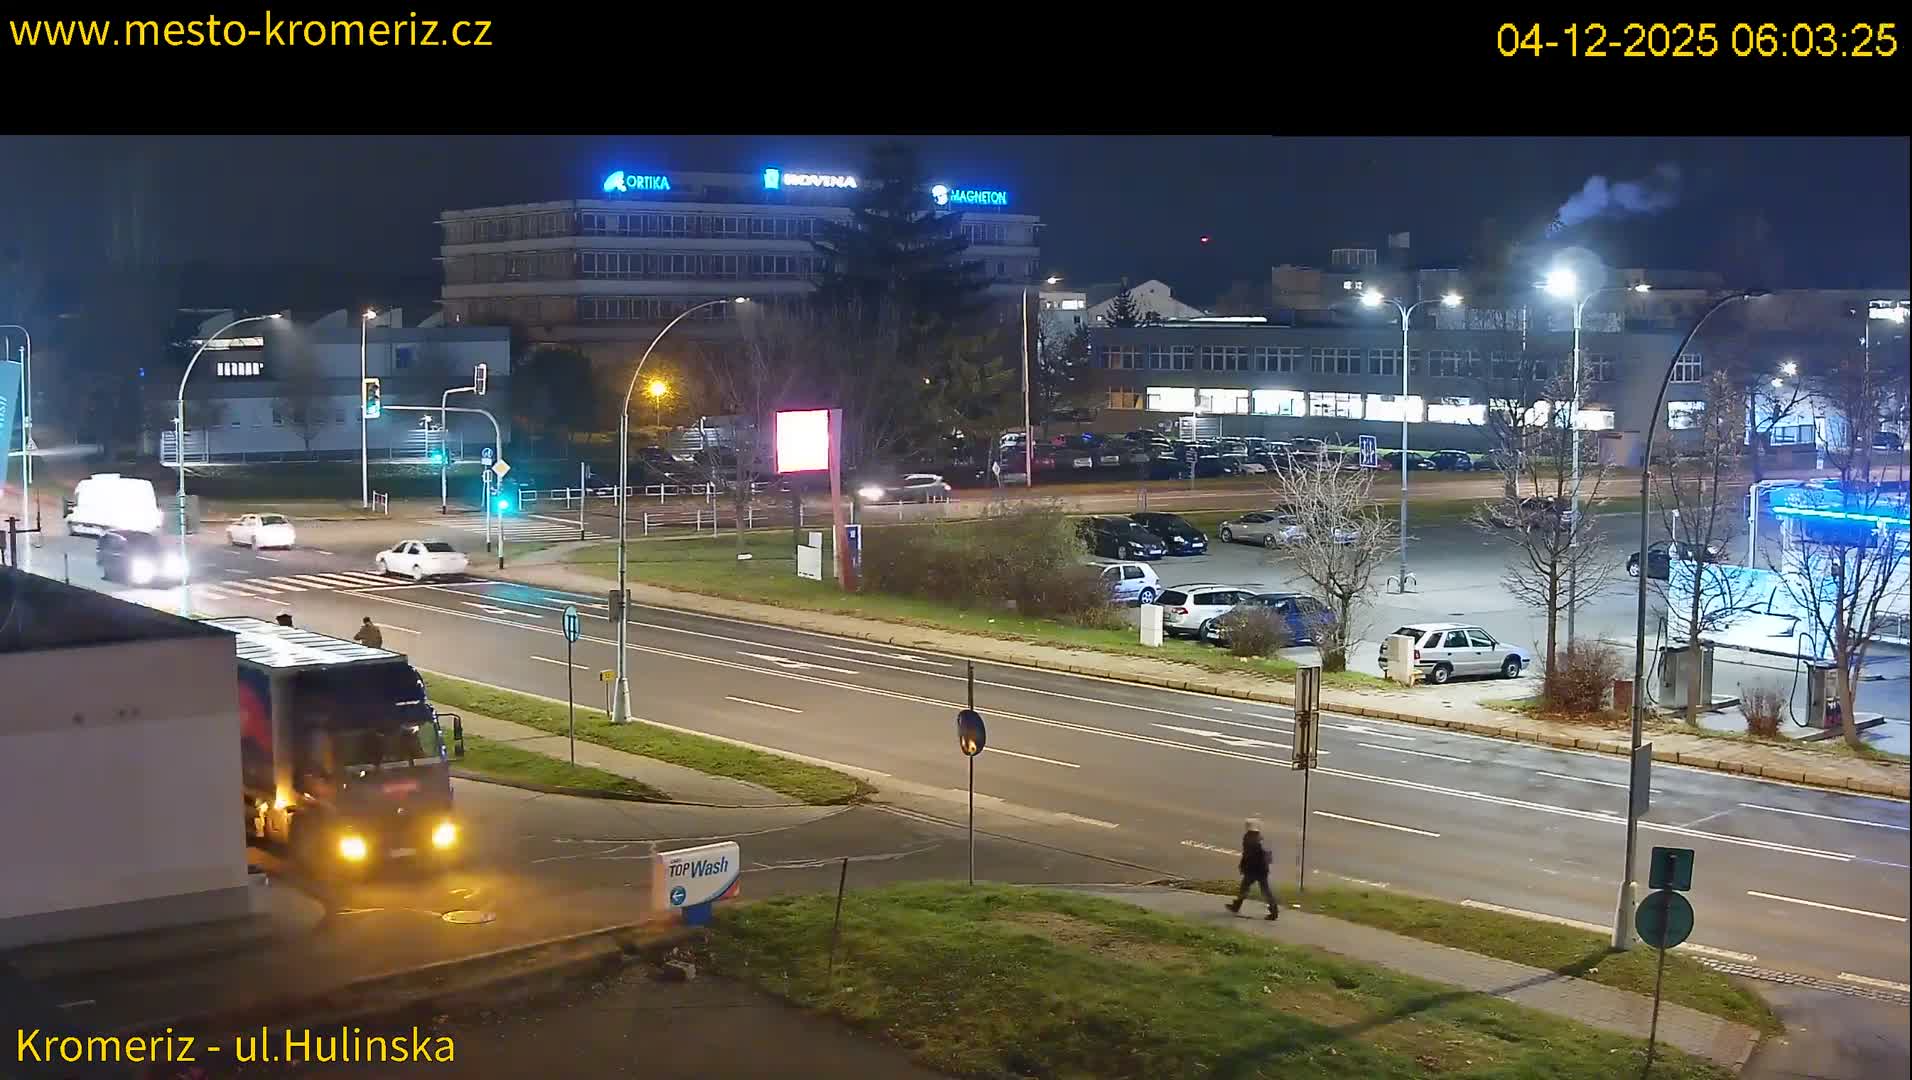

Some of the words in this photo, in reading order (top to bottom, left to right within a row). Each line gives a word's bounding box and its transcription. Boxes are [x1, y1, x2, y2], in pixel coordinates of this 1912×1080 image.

[627, 175, 670, 190] ORTIKA
[950, 189, 1008, 205] MAGNETON
[669, 862, 690, 877] TOP
[691, 856, 728, 878] Wash
